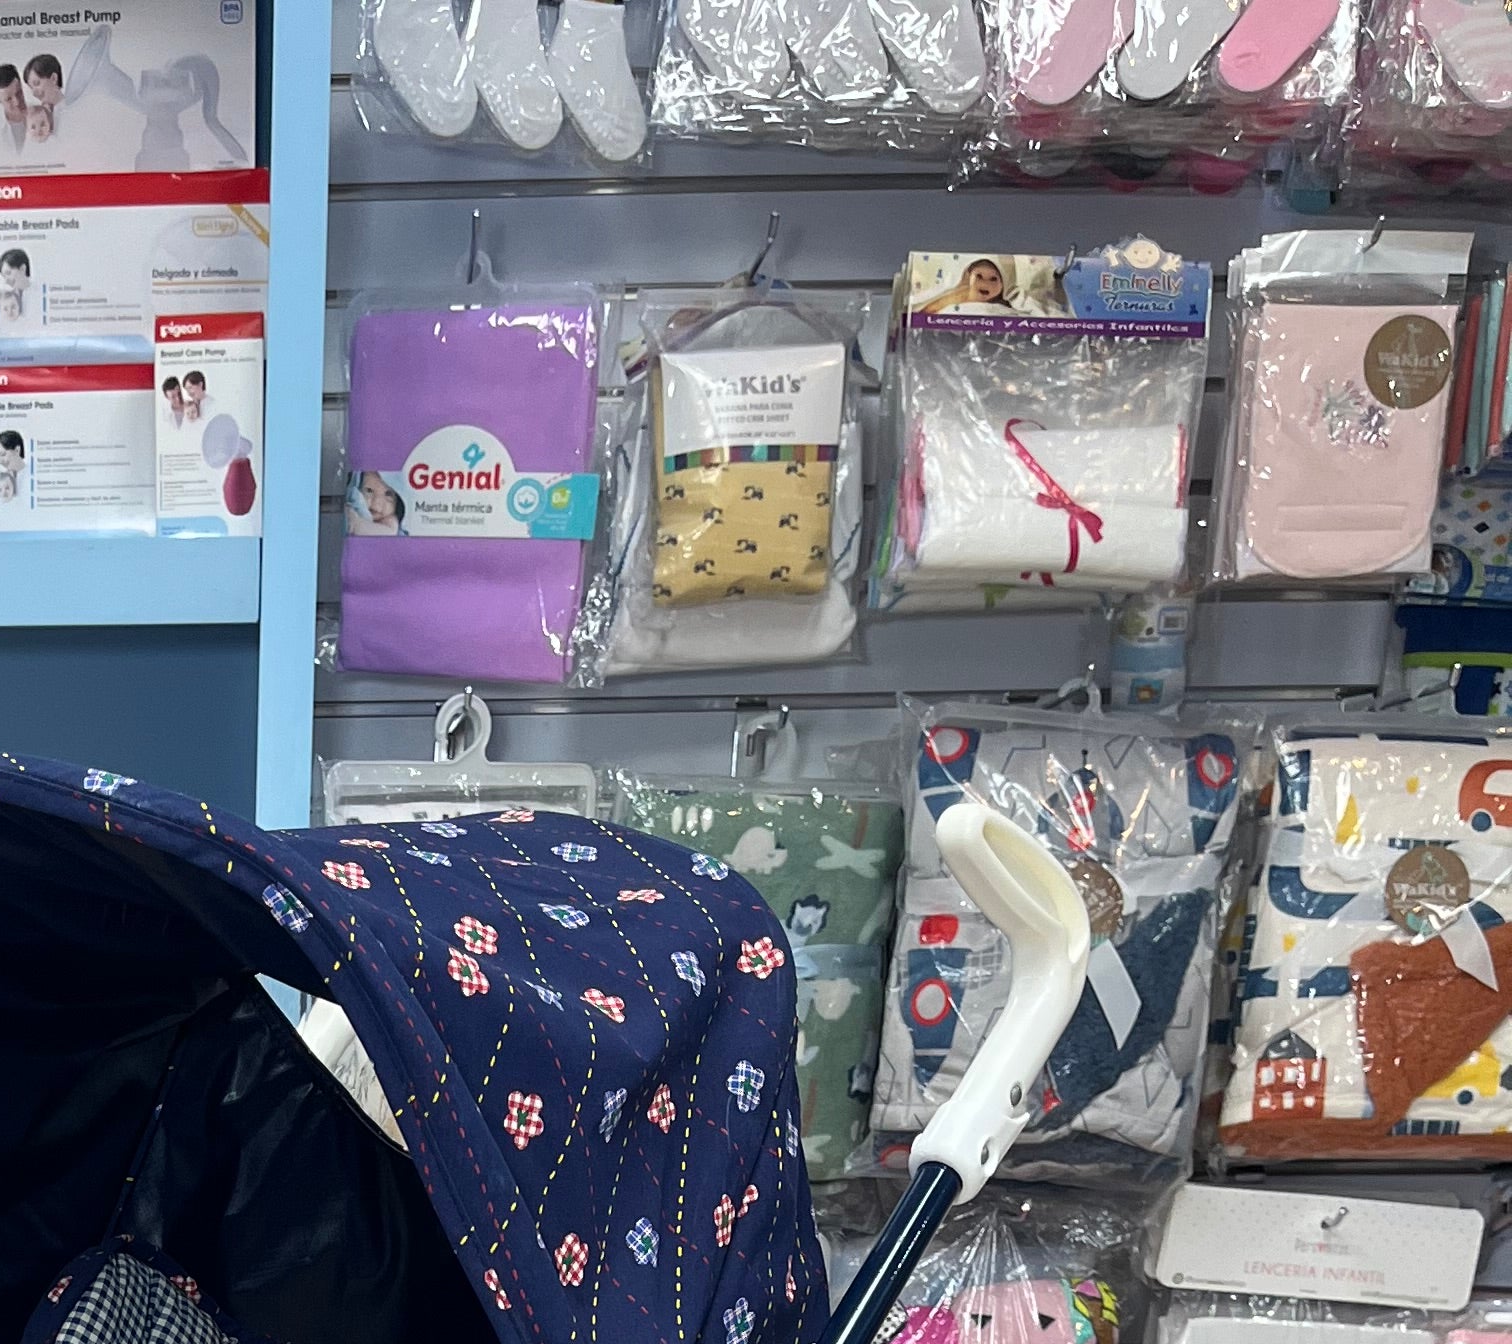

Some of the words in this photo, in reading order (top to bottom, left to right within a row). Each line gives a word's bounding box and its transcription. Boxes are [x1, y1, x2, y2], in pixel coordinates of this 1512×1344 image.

[40, 11, 81, 24] Breast
[84, 10, 122, 26] Pump
[22, 218, 54, 231] Breast
[55, 217, 80, 230] Pads
[152, 267, 192, 281] Delgado
[159, 321, 203, 338] pigeon
[408, 463, 501, 491] Genial
[414, 502, 449, 513] Manta
[451, 502, 494, 514] térmica
